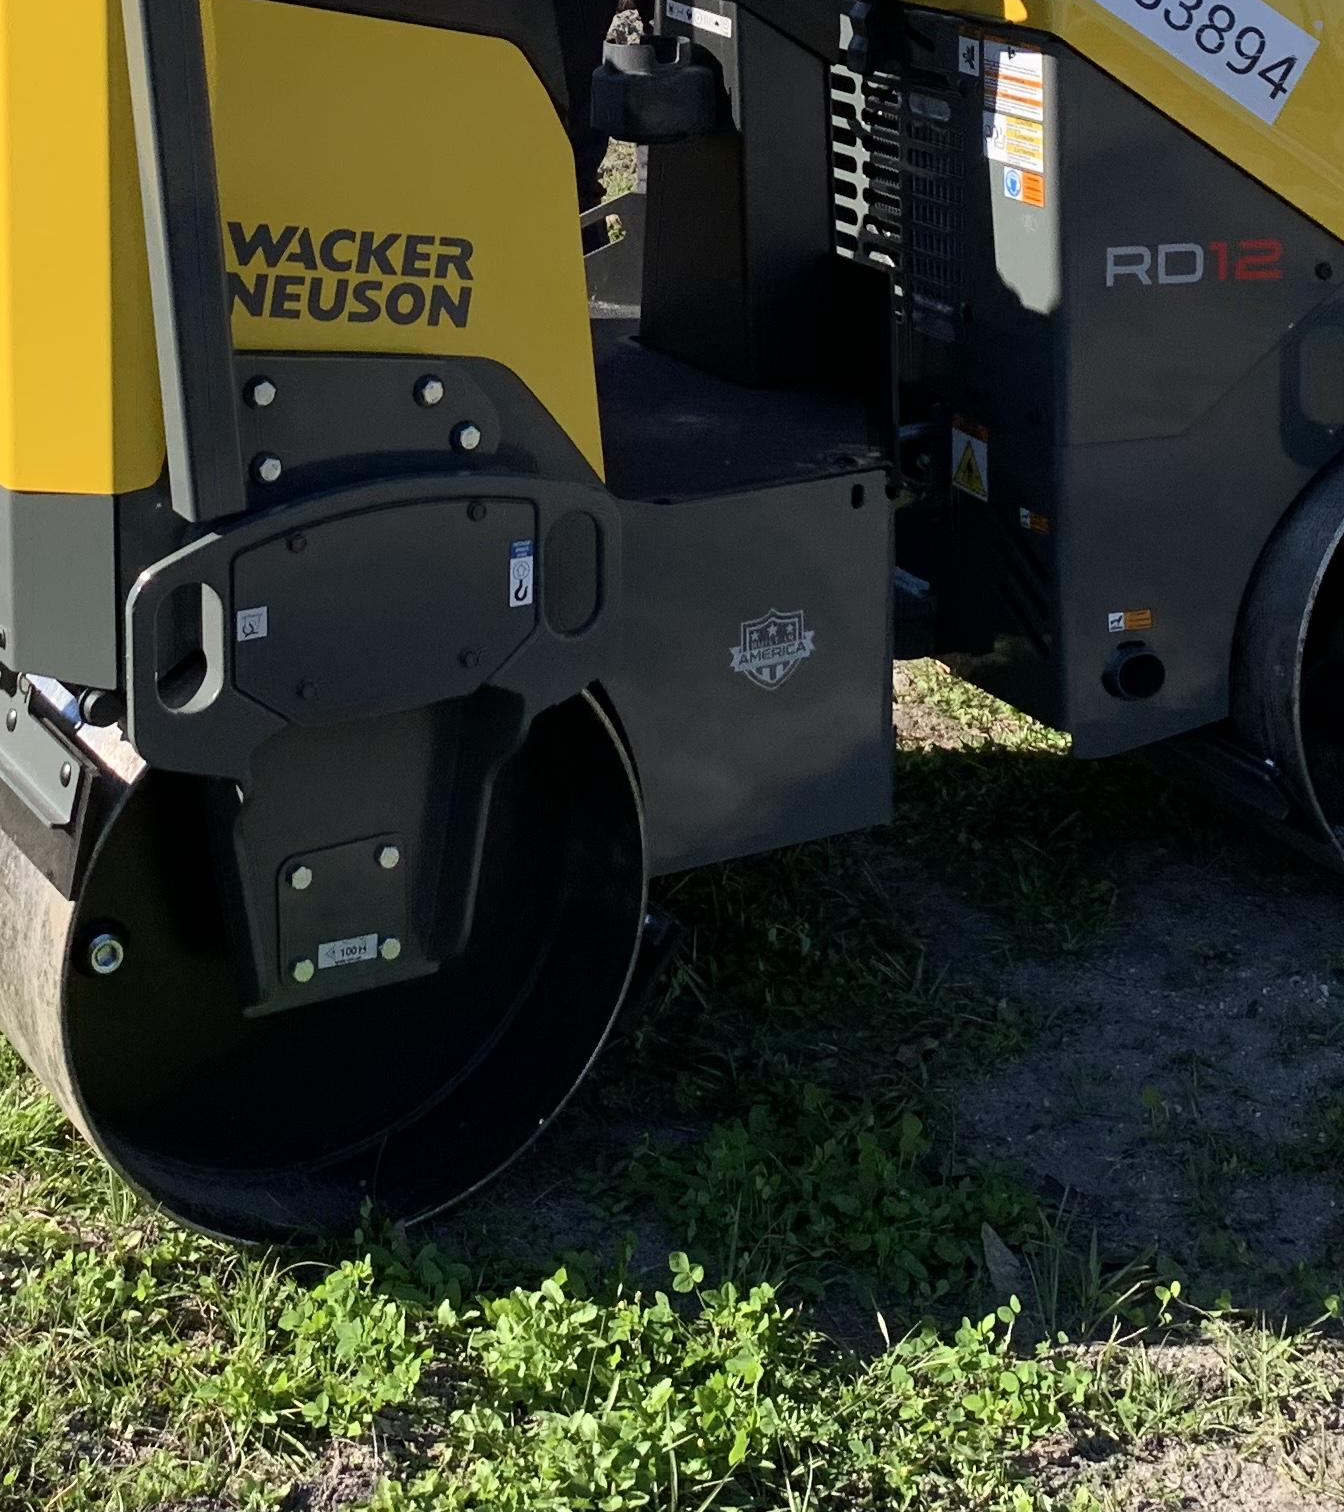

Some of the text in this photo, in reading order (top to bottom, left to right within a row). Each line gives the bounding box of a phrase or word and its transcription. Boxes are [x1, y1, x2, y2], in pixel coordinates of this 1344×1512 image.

[227, 221, 474, 281] WACKER
[1106, 238, 1285, 287] RD12
[226, 272, 473, 328] NEUSON
[738, 641, 807, 666] AMERICA
